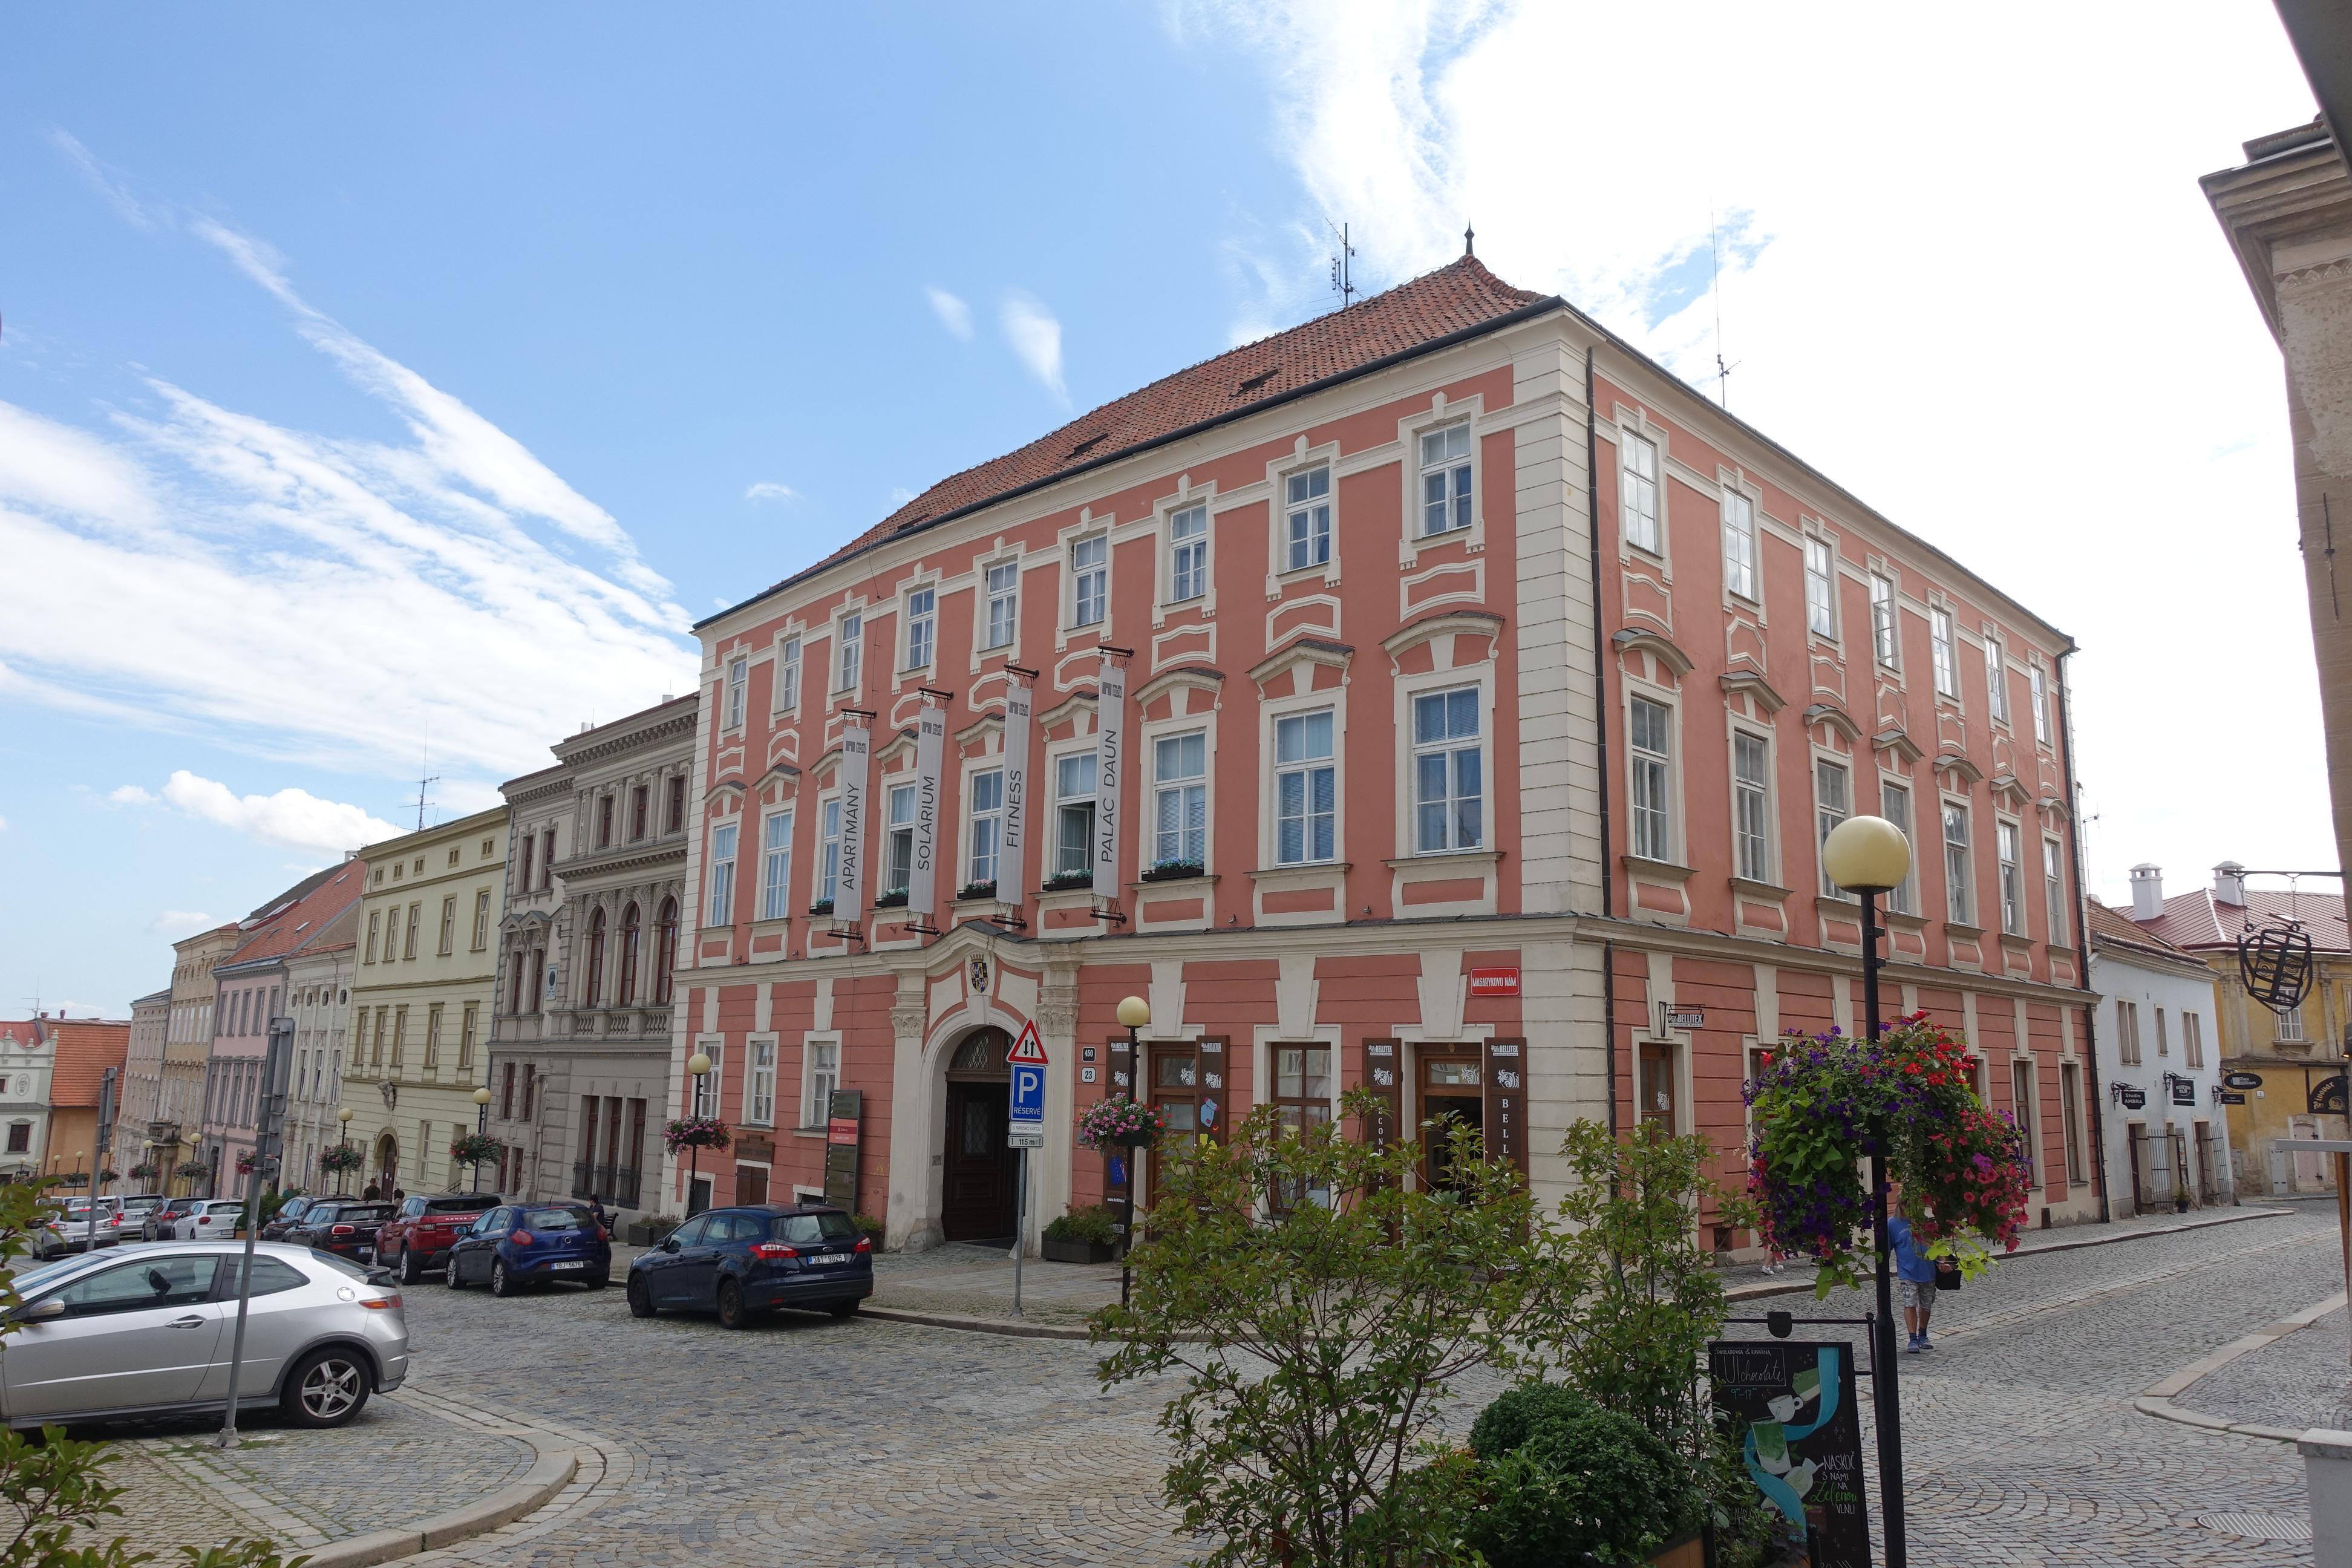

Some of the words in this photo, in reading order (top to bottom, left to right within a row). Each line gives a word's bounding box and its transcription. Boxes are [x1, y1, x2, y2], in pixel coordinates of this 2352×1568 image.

[1104, 730, 1117, 787] DAUN
[1007, 769, 1022, 848] FITNESS
[918, 776, 935, 871] SOLÁRIUM
[1100, 798, 1114, 862] PALÁC
[843, 783, 860, 890] APARTMÁNY
[1472, 977, 1503, 987] MASARYKOVO
[1677, 1014, 1702, 1023] BELLITEX
[1085, 1071, 1093, 1079] 23
[1019, 1072, 1038, 1103] P
[2313, 1082, 2335, 1109] Pivovar
[1014, 1106, 1041, 1115] RÉSERVÉ
[1823, 1451, 1855, 1471] NASKOČ
[1822, 1471, 1828, 1481] S
[1830, 1471, 1849, 1481] NÁMI
[1837, 1482, 1848, 1491] NA
[1835, 1504, 1855, 1515] VLNU
